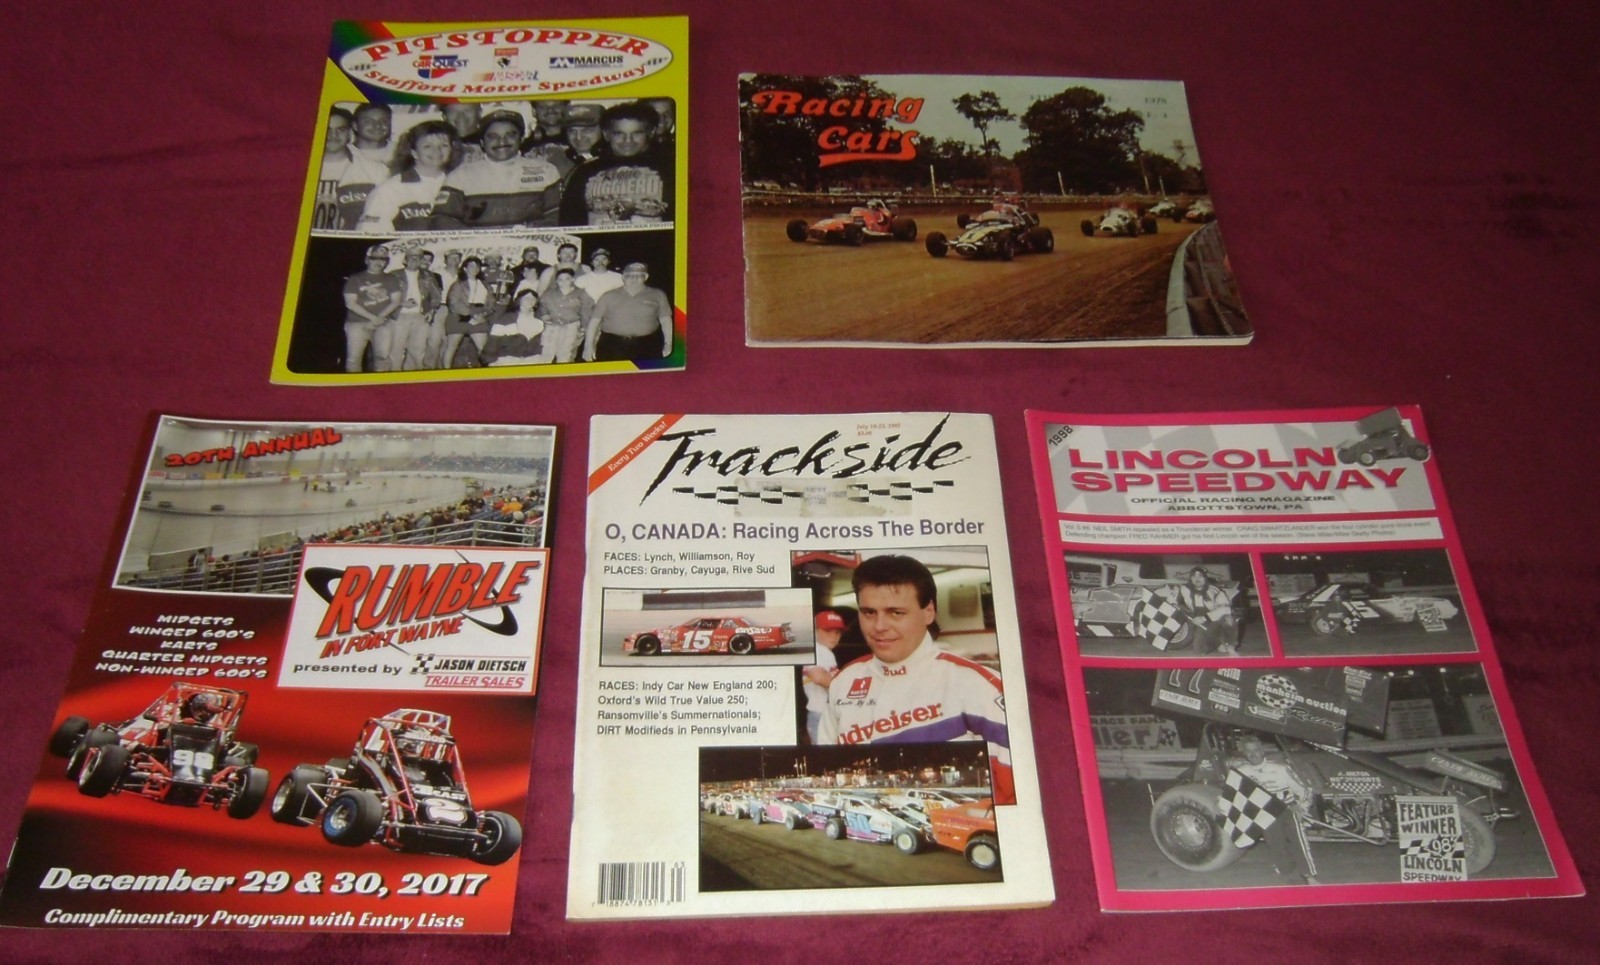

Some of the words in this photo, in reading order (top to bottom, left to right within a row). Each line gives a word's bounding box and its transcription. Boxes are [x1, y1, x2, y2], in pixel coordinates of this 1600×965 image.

[363, 29, 650, 61] PITSTOPPER
[575, 55, 624, 64] MARCUS
[364, 69, 457, 93] Stafford
[462, 82, 531, 94] Motor
[538, 66, 647, 92] Speedway
[751, 90, 925, 124] Racing
[817, 126, 921, 166] Cars
[1047, 424, 1075, 447] 1998
[165, 446, 235, 468] 20TH
[243, 426, 343, 458] ANNUAL
[607, 450, 629, 473] Every
[625, 439, 645, 459] Two
[639, 412, 971, 506] Trackside
[1069, 447, 1337, 470] LINCOLN
[1071, 467, 1407, 493] SPEEDWAY
[1131, 496, 1196, 504] OFFICIAL
[1200, 496, 1256, 504] RACING
[1259, 495, 1335, 504] MAGAZINE
[1284, 503, 1304, 511] PA
[605, 523, 626, 543] O,
[632, 523, 728, 540] CANADA:
[733, 522, 800, 543] Racing
[805, 521, 873, 539] Across
[878, 520, 916, 537] The
[920, 519, 984, 536] Border
[604, 552, 641, 562] FACES:
[644, 552, 675, 564] Lynch,
[678, 552, 733, 564] Williamson,
[736, 551, 755, 564] Roy
[603, 565, 647, 576] PLACES:
[650, 565, 687, 577] Granby,
[690, 565, 729, 577] Cayuga,
[732, 564, 753, 575] Rive
[755, 564, 775, 575] Sud
[315, 560, 541, 639] RUMBLE
[157, 614, 235, 627] MIDGETS
[129, 626, 198, 638] WINGED
[202, 628, 255, 640] 600'S
[320, 641, 346, 659] IN
[342, 630, 398, 652] FORT
[397, 617, 466, 646] WAYNE
[682, 630, 714, 650] 15
[161, 640, 218, 651] KARTS
[102, 650, 185, 664] QUARTER
[190, 654, 268, 667] MIDGETS
[434, 659, 475, 671] JASON
[478, 659, 527, 672] DIETSCH
[95, 662, 209, 678] NON-WINGED
[214, 667, 268, 680] 600'S
[294, 662, 378, 675] presented
[383, 663, 403, 676] by
[882, 665, 907, 677] Bud
[425, 674, 479, 687] TRAILER
[481, 675, 525, 688] SALES
[599, 681, 639, 691] RACES:
[642, 681, 663, 693] Indy
[667, 681, 684, 691] Car
[687, 681, 709, 691] New
[713, 680, 753, 692] England
[756, 680, 778, 692] 200;
[598, 695, 640, 706] Oxford's
[645, 695, 666, 705] Wild
[669, 695, 693, 705] True
[697, 694, 723, 705] Value
[727, 694, 748, 706] 250;
[1256, 683, 1304, 703] manheim
[1306, 697, 1347, 716] auction
[597, 710, 667, 721] Ransomville's
[670, 709, 761, 721] Summernationals;
[597, 725, 621, 735] DIRT
[625, 724, 675, 735] Modifieds
[678, 724, 688, 735] in
[690, 724, 757, 736] Pennsylvania
[422, 798, 468, 824] 2
[1400, 803, 1454, 822] FEATURE
[1401, 816, 1457, 836] WINNER
[1404, 856, 1462, 873] LINCOLN
[39, 867, 235, 892] December
[239, 870, 290, 892] 29
[294, 871, 325, 894] &
[330, 871, 388, 897] 30,
[397, 871, 489, 896] 2017
[44, 908, 208, 928] Complimentary
[211, 910, 304, 928] Program
[309, 912, 355, 928] with
[358, 913, 415, 930] Entry
[417, 912, 465, 928] Lists
